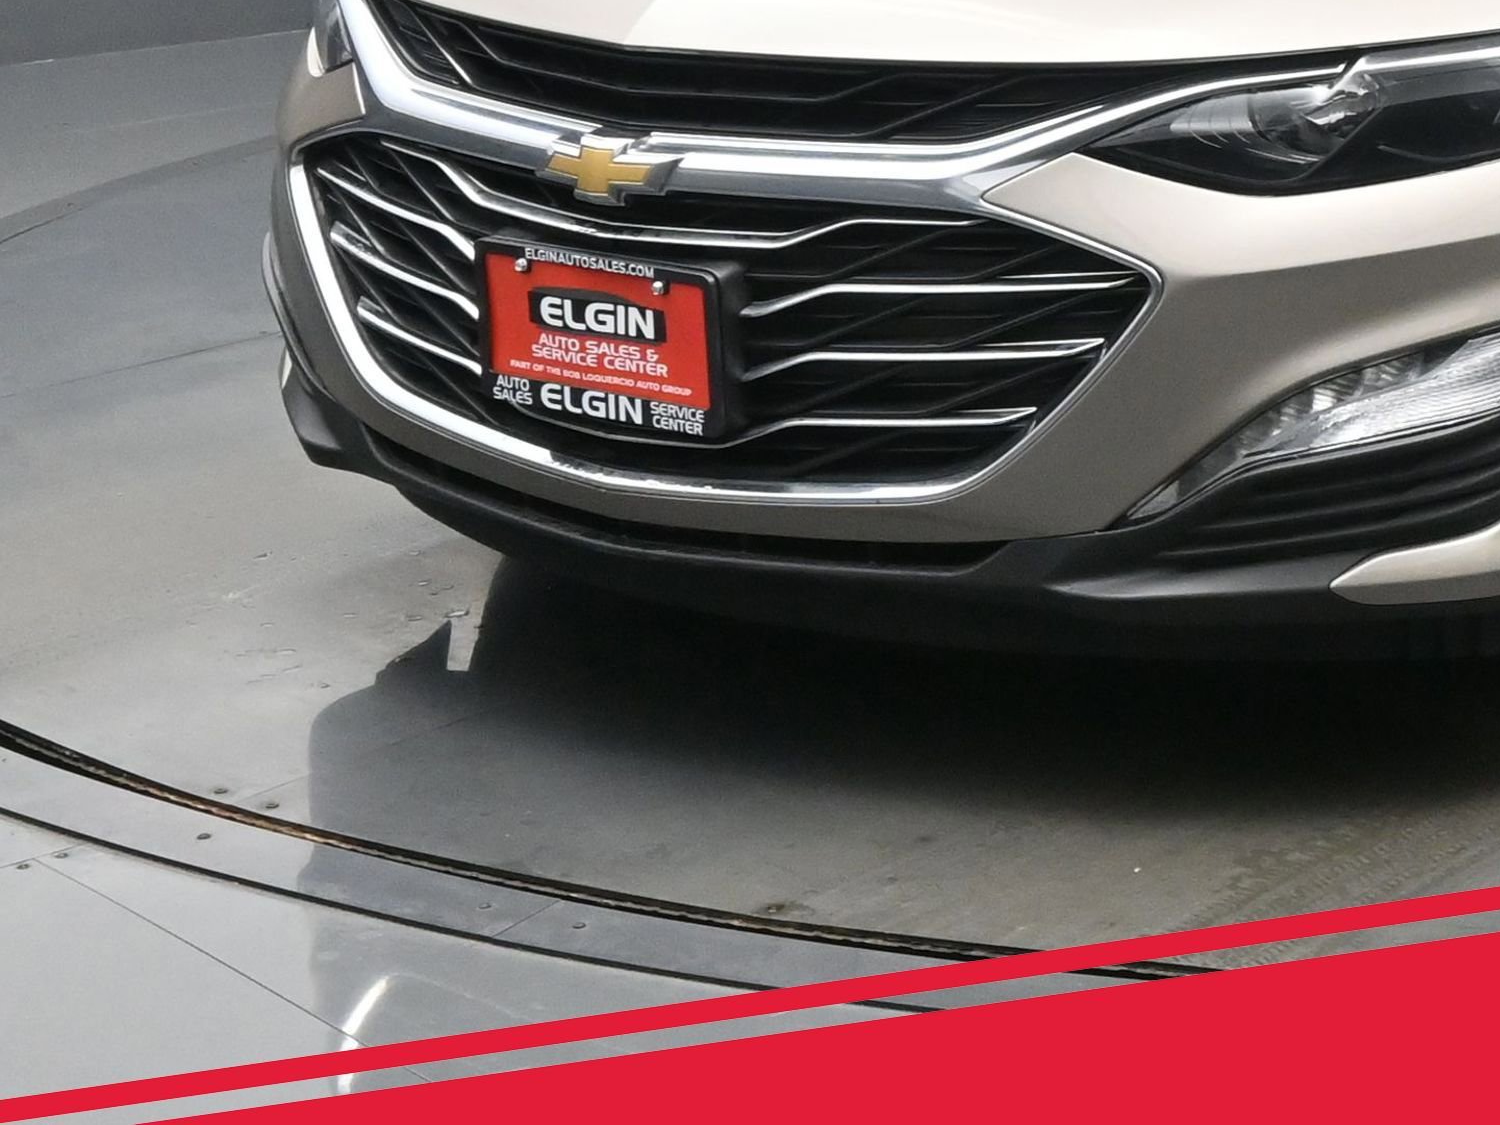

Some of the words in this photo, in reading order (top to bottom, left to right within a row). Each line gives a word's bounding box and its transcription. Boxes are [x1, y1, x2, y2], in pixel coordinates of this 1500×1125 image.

[525, 248, 654, 278] ELGINAUTOSALES.COM
[540, 296, 655, 339] ELGIN
[532, 345, 598, 367] SERVICE
[604, 355, 669, 378] CENTER
[539, 333, 580, 350] AUTO
[586, 340, 640, 359] SALES
[646, 348, 659, 362] &
[496, 375, 530, 391] AUTO
[510, 359, 531, 370] PART
[532, 363, 545, 373] OF
[636, 381, 660, 392] AUTO
[661, 384, 692, 396] GROUP
[493, 387, 533, 405] SALES
[540, 383, 643, 425] ELGIN
[650, 402, 705, 423] SERVICE
[653, 416, 704, 436] CENTER
